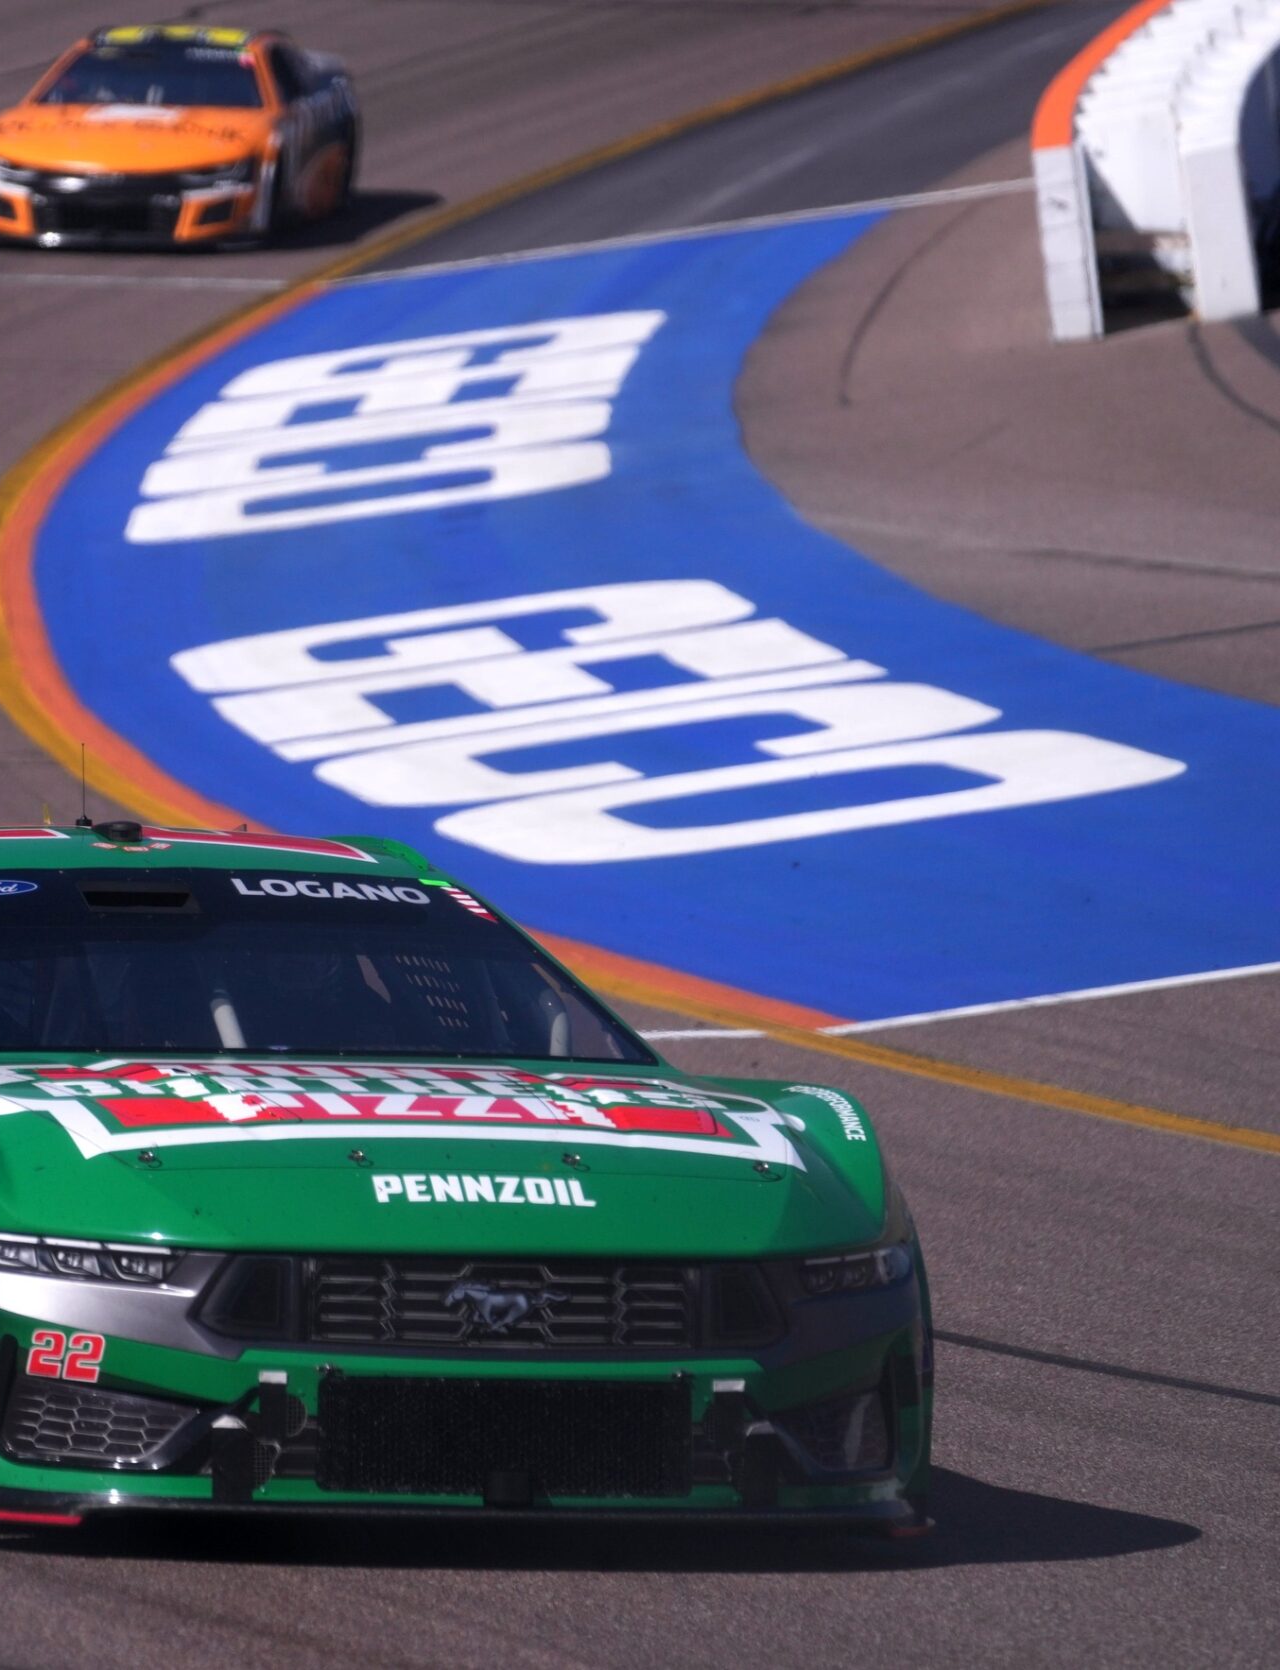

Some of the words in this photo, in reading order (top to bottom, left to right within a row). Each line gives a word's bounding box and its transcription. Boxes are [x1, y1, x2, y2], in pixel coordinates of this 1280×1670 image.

[124, 309, 667, 545] GEICO
[170, 579, 1187, 865] GEICO
[231, 878, 431, 905] LOGANO
[203, 1093, 620, 1128] PIZZA
[372, 1175, 597, 1208] PENNZOIL
[26, 1328, 105, 1384] 22
